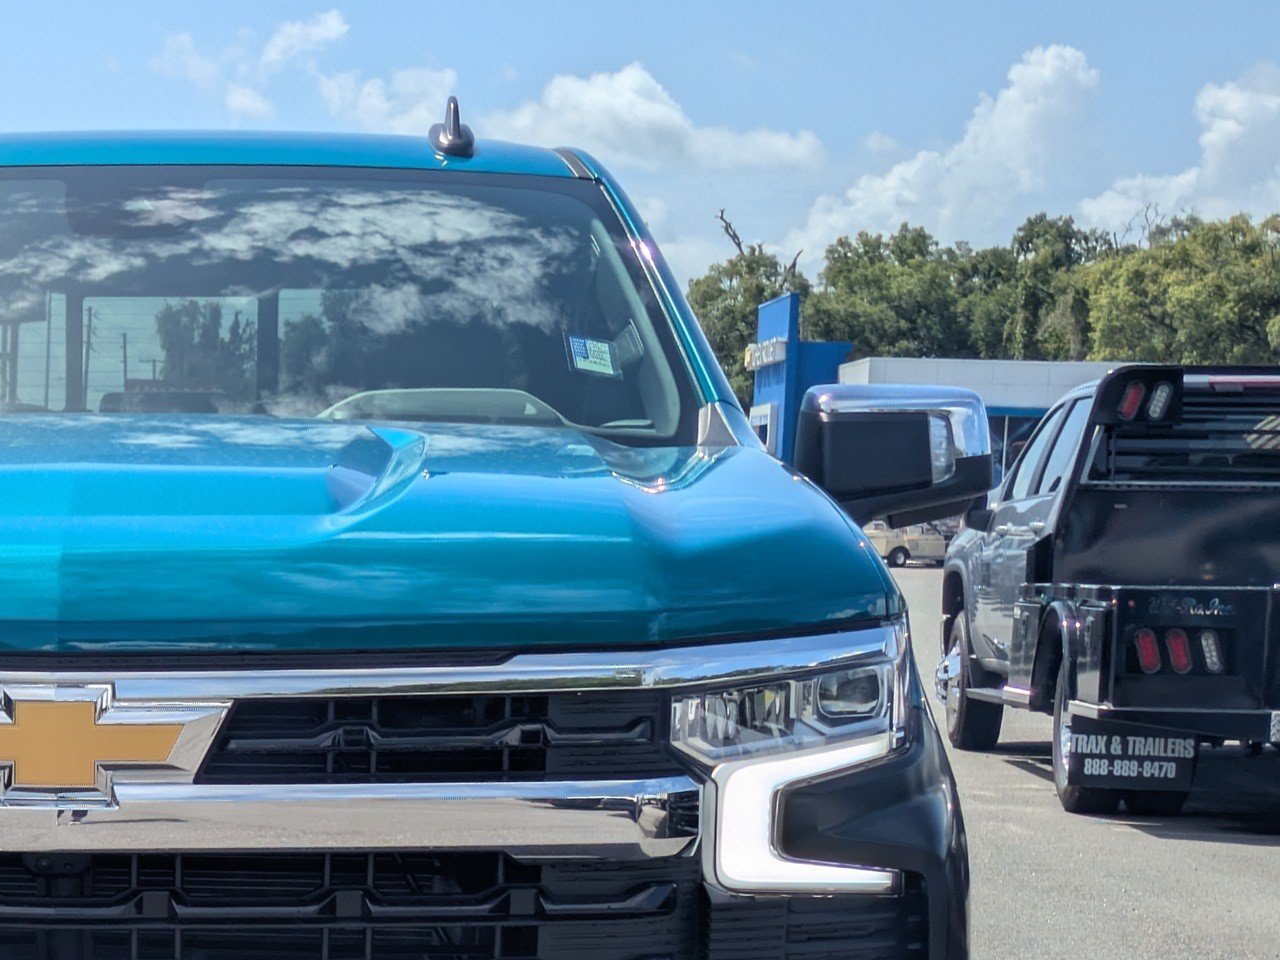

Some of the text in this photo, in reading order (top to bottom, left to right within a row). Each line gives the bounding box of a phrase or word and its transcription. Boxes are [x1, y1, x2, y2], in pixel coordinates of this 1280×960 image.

[1071, 733, 1195, 759] TRAX & TRAILERS
[1083, 758, 1177, 779] 888-889-8470
